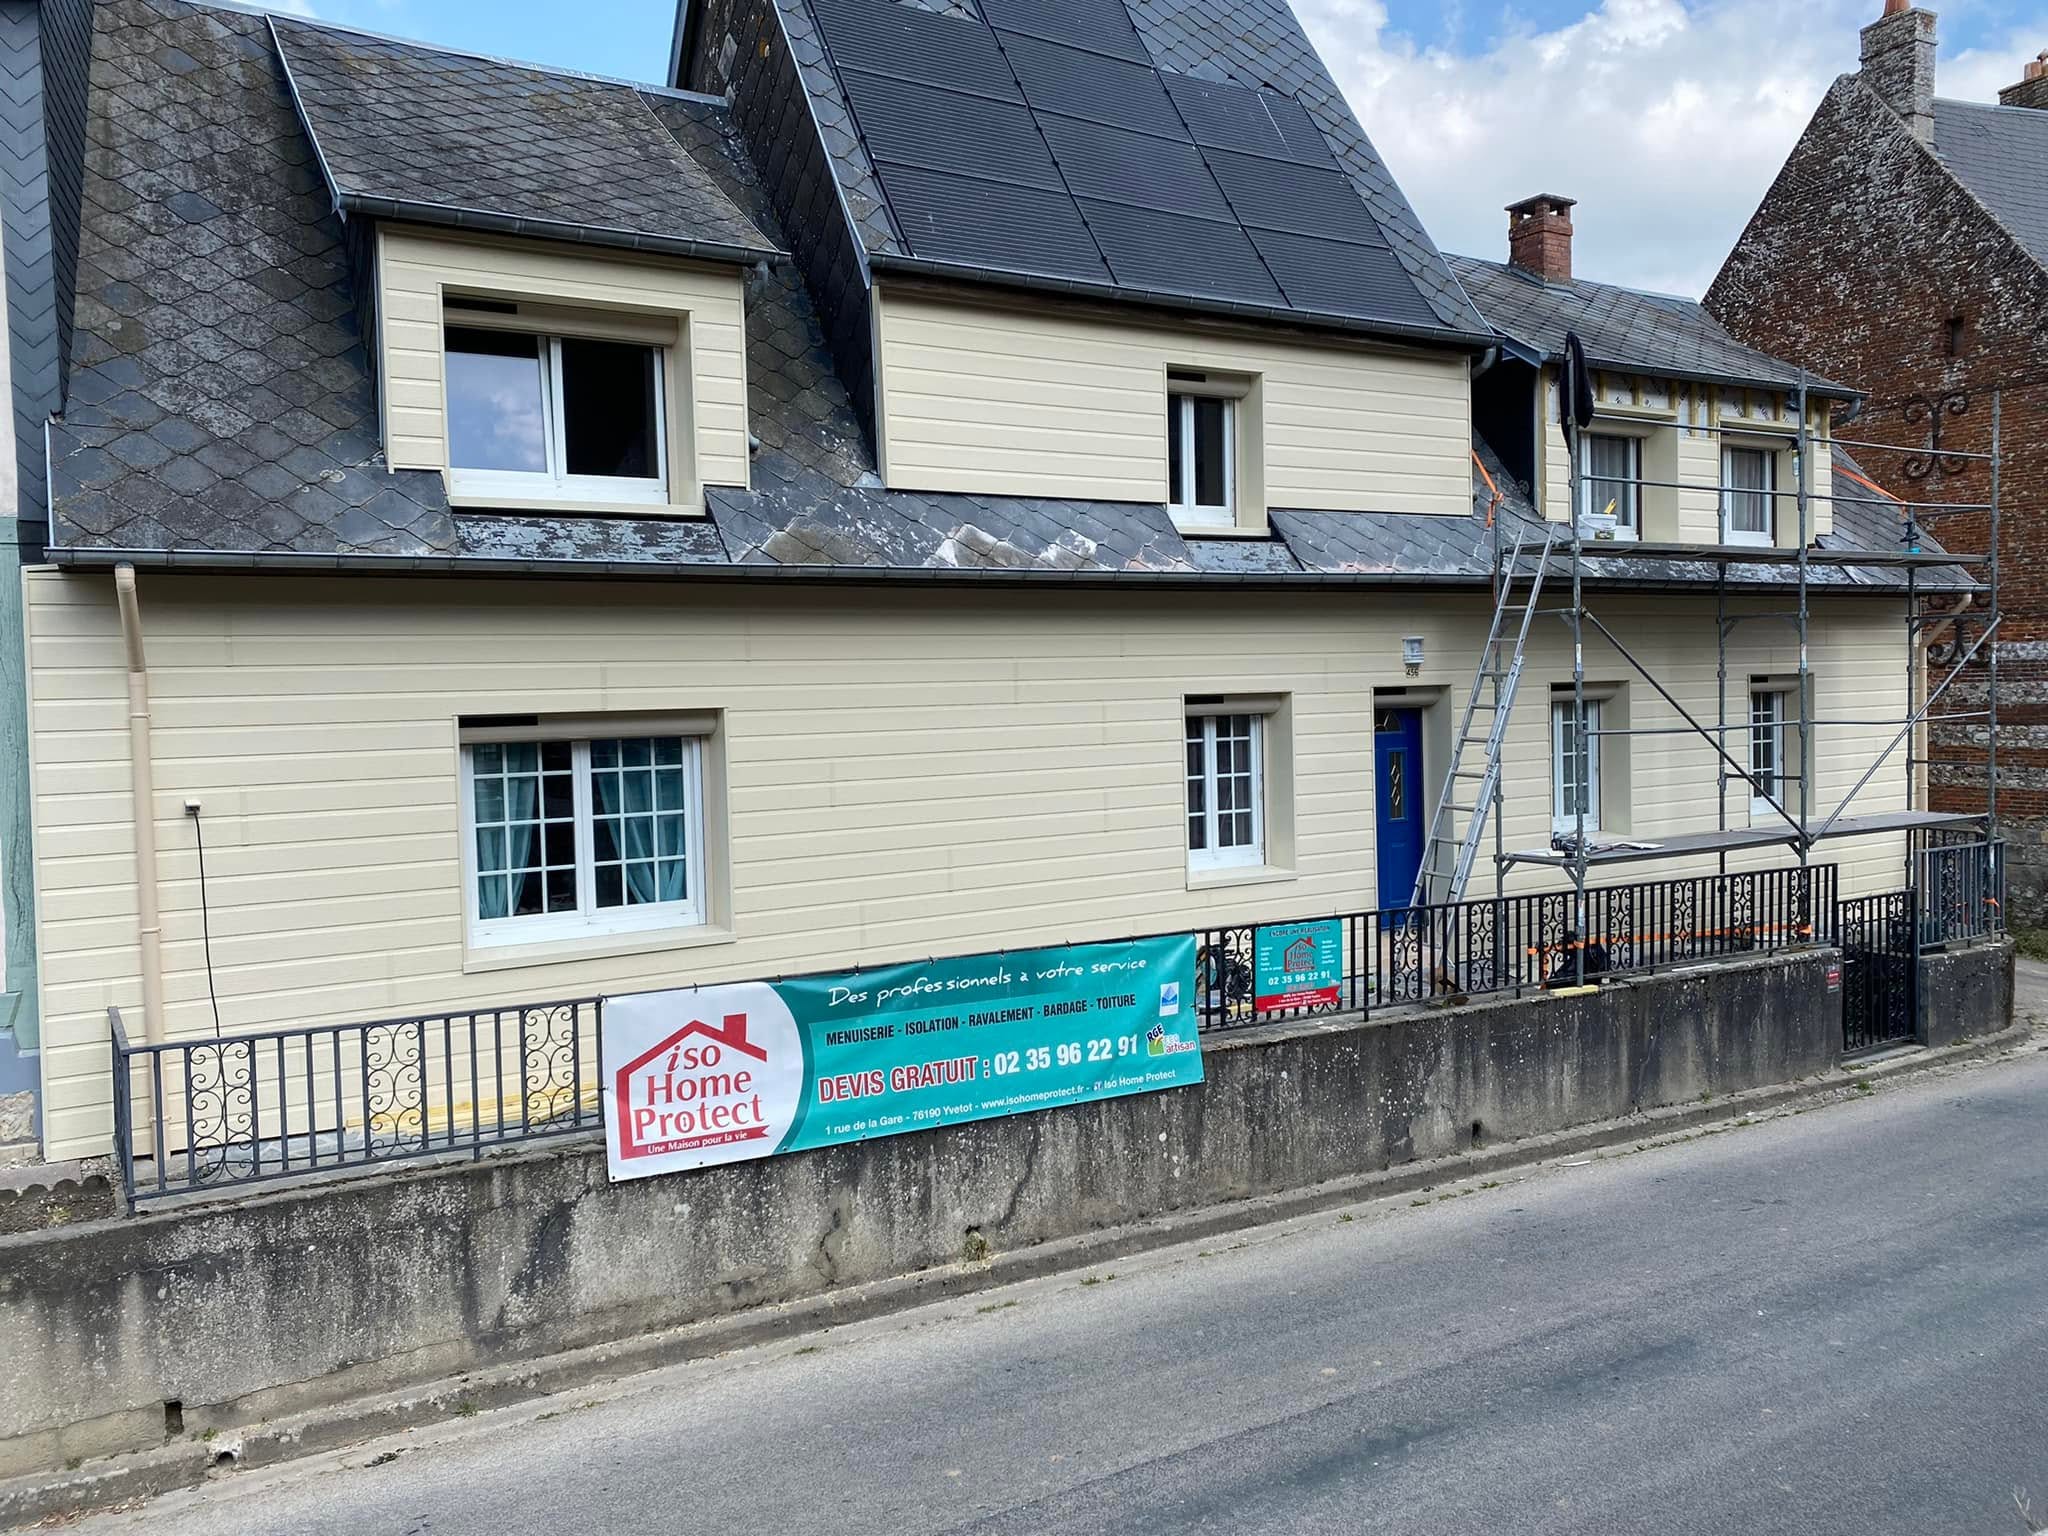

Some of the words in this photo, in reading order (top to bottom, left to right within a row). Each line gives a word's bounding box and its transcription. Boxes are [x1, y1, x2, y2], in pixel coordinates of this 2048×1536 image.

[828, 986, 868, 1007] Des
[876, 967, 1012, 1007] professionnels
[1019, 971, 1029, 982] à
[1036, 961, 1084, 979] votre
[1091, 957, 1147, 973] service
[1268, 977, 1280, 986] 02
[1281, 975, 1292, 984] 35
[1295, 974, 1306, 983] 96
[1308, 972, 1318, 981] 22
[1320, 970, 1330, 979] 91
[826, 1025, 895, 1046] MENUISERIE
[905, 1016, 959, 1035] ISOLATION
[968, 1007, 1034, 1026] RAVALEMENT
[1043, 1000, 1088, 1017] BARDAGE
[1097, 994, 1136, 1010] TOITURE
[1146, 1024, 1164, 1042] RGE
[667, 1045, 721, 1072] iso
[1166, 1041, 1195, 1053] artisan
[819, 1070, 884, 1103] DEVIS
[891, 1056, 977, 1092] GRATUIT
[994, 1051, 1020, 1076] 02
[1026, 1047, 1051, 1071] 35
[1057, 1042, 1082, 1066] 96
[1087, 1038, 1113, 1062] 22
[1118, 1035, 1138, 1055] 91
[647, 1070, 752, 1106] Home
[826, 1127, 831, 1135] 1
[834, 1124, 850, 1133] rue
[854, 1120, 866, 1131] de
[868, 1118, 878, 1128] la
[880, 1114, 904, 1126] Gare
[913, 1109, 941, 1121] 76190
[942, 1103, 973, 1116] Yvetot
[981, 1085, 1084, 1110] www.isohomeprotect.fr
[1119, 1075, 1144, 1086] Home
[1146, 1070, 1176, 1083] Protect
[634, 1094, 764, 1141] Protect
[647, 1145, 665, 1154] Une
[668, 1140, 700, 1152] Maison
[702, 1136, 722, 1148] pour
[724, 1133, 733, 1142] la
[735, 1131, 748, 1141] vie
